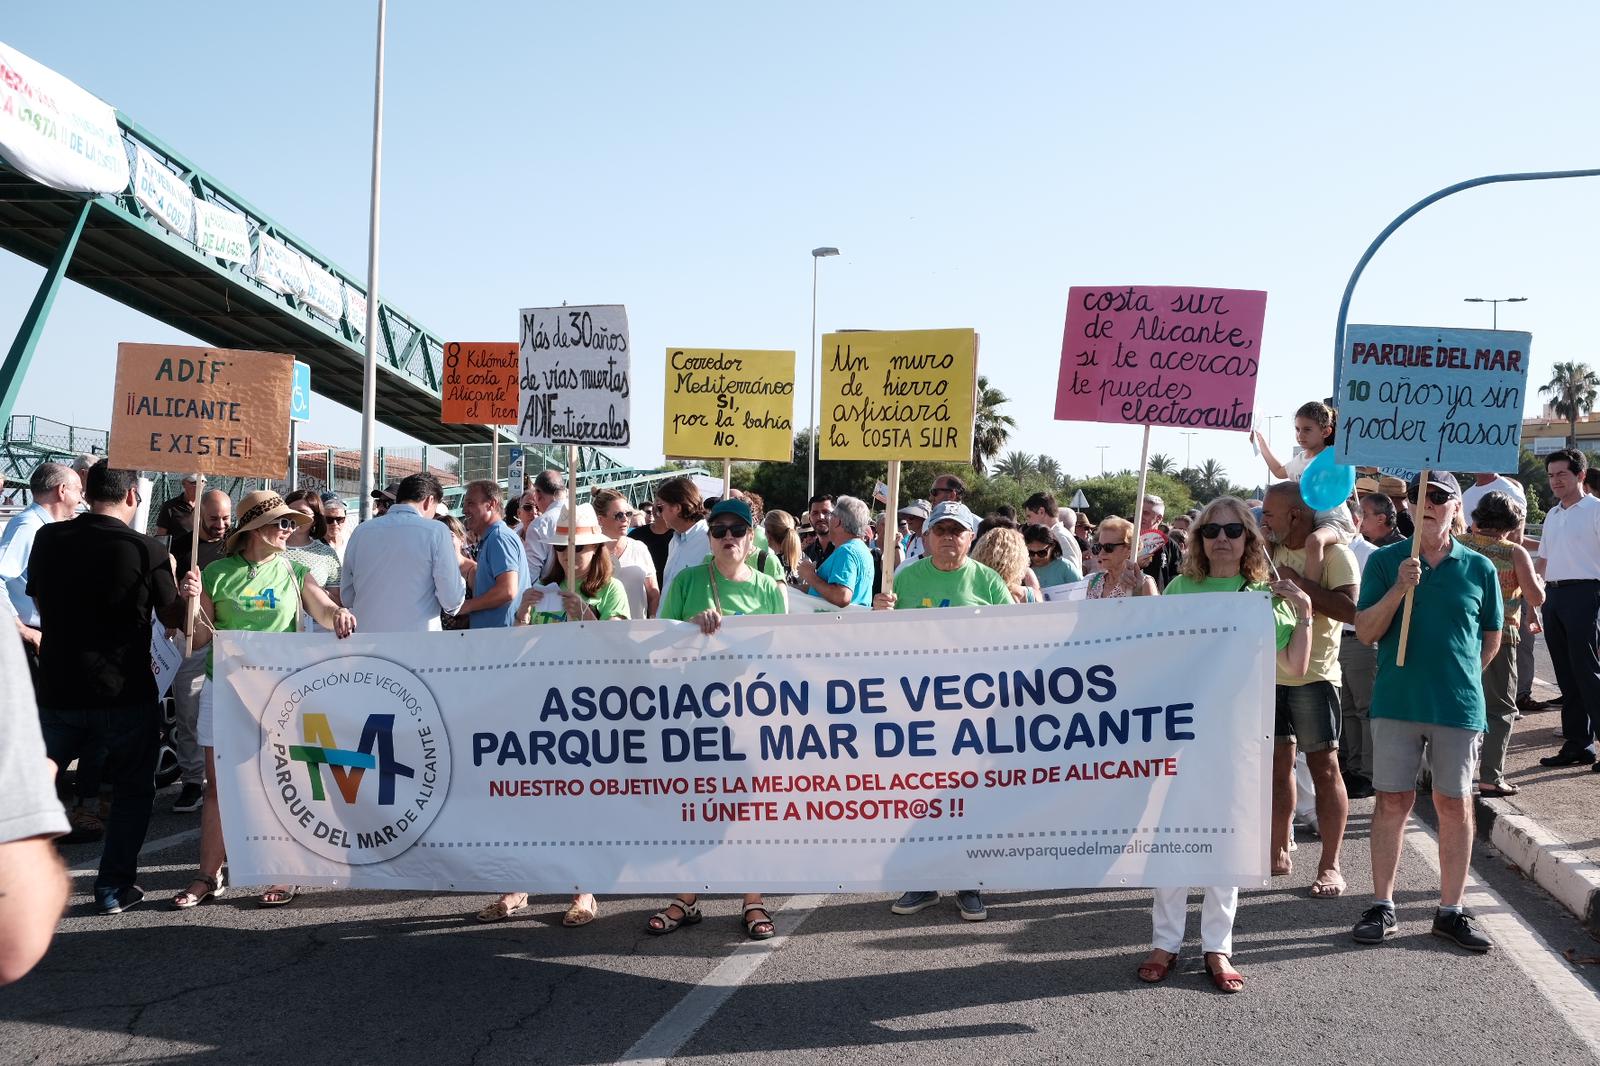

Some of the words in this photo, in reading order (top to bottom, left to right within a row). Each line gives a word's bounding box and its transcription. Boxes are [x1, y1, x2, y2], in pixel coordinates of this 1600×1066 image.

[1083, 288, 1154, 311] costa
[1171, 294, 1229, 315] sur
[520, 314, 550, 352] Más
[553, 316, 572, 348] de
[569, 311, 593, 348] 30
[593, 327, 628, 352] años
[1084, 313, 1113, 338] de
[1130, 316, 1253, 349] Alicante,
[447, 342, 461, 368] 8
[671, 351, 743, 371] Corredor
[830, 345, 869, 371] Un
[890, 354, 954, 370] muro
[1076, 344, 1098, 366] si
[1112, 343, 1138, 367] te
[1150, 351, 1258, 376] acercas
[1351, 343, 1434, 367] PARQUE
[1436, 347, 1471, 369] DEL
[1474, 349, 1525, 375] MAR,
[447, 368, 461, 385] de
[466, 370, 500, 385] costa
[520, 357, 540, 391] de
[543, 361, 578, 390] vías
[580, 356, 630, 398] muertas
[674, 373, 793, 395] Mediterráneo
[841, 372, 863, 396] de
[883, 369, 949, 396] hierro
[1069, 371, 1092, 394] te
[1100, 375, 1192, 405] puedes
[447, 385, 507, 401] Alicante
[1347, 380, 1371, 401] 10
[1379, 377, 1444, 405] años
[1447, 385, 1475, 420] ya
[1481, 380, 1519, 409] sin
[466, 402, 479, 418] el
[491, 403, 518, 418] tren
[673, 413, 708, 434] por
[715, 410, 734, 427] la
[743, 410, 792, 430] bahía
[833, 397, 950, 431] asfixiará
[714, 431, 738, 447] NO.
[829, 424, 849, 447] la
[863, 428, 912, 448] COSTA
[920, 427, 957, 448] SUR
[1343, 407, 1427, 455] poder
[1438, 421, 1519, 462] pasar
[277, 672, 351, 730] ASOCIACIÓN
[353, 672, 374, 685] DE
[375, 674, 423, 717] VECINOS
[540, 672, 809, 722] ASOCIACIÓN
[826, 677, 887, 715] DE
[900, 664, 1117, 712] VECINOS
[472, 728, 648, 767] PARQUE
[661, 726, 746, 763] DEL
[760, 723, 858, 760] MAR
[874, 720, 936, 758] DE
[951, 702, 1195, 755] ALICANTE
[273, 743, 315, 828] PARQUE
[313, 821, 352, 849] DEL
[357, 825, 398, 849] MAR
[395, 809, 419, 833] DE
[418, 726, 437, 811] ALICANTE
[489, 778, 585, 797] NUESTRO
[589, 777, 689, 796] OBJETIVO
[694, 777, 717, 794] ES
[722, 776, 748, 793] LA
[751, 774, 841, 793] MEJORA
[846, 773, 886, 791] DEL
[889, 770, 979, 791] ACCESO
[984, 768, 1027, 788] SUR
[1032, 765, 1060, 785] DE
[1064, 758, 1177, 782] ALICANTE
[702, 797, 778, 822] ÚNETE
[782, 802, 802, 821] A
[807, 798, 943, 821] NOSOTR@S
[949, 798, 964, 818] !!
[966, 840, 1213, 862] www.avparquedelmaralicante.com
